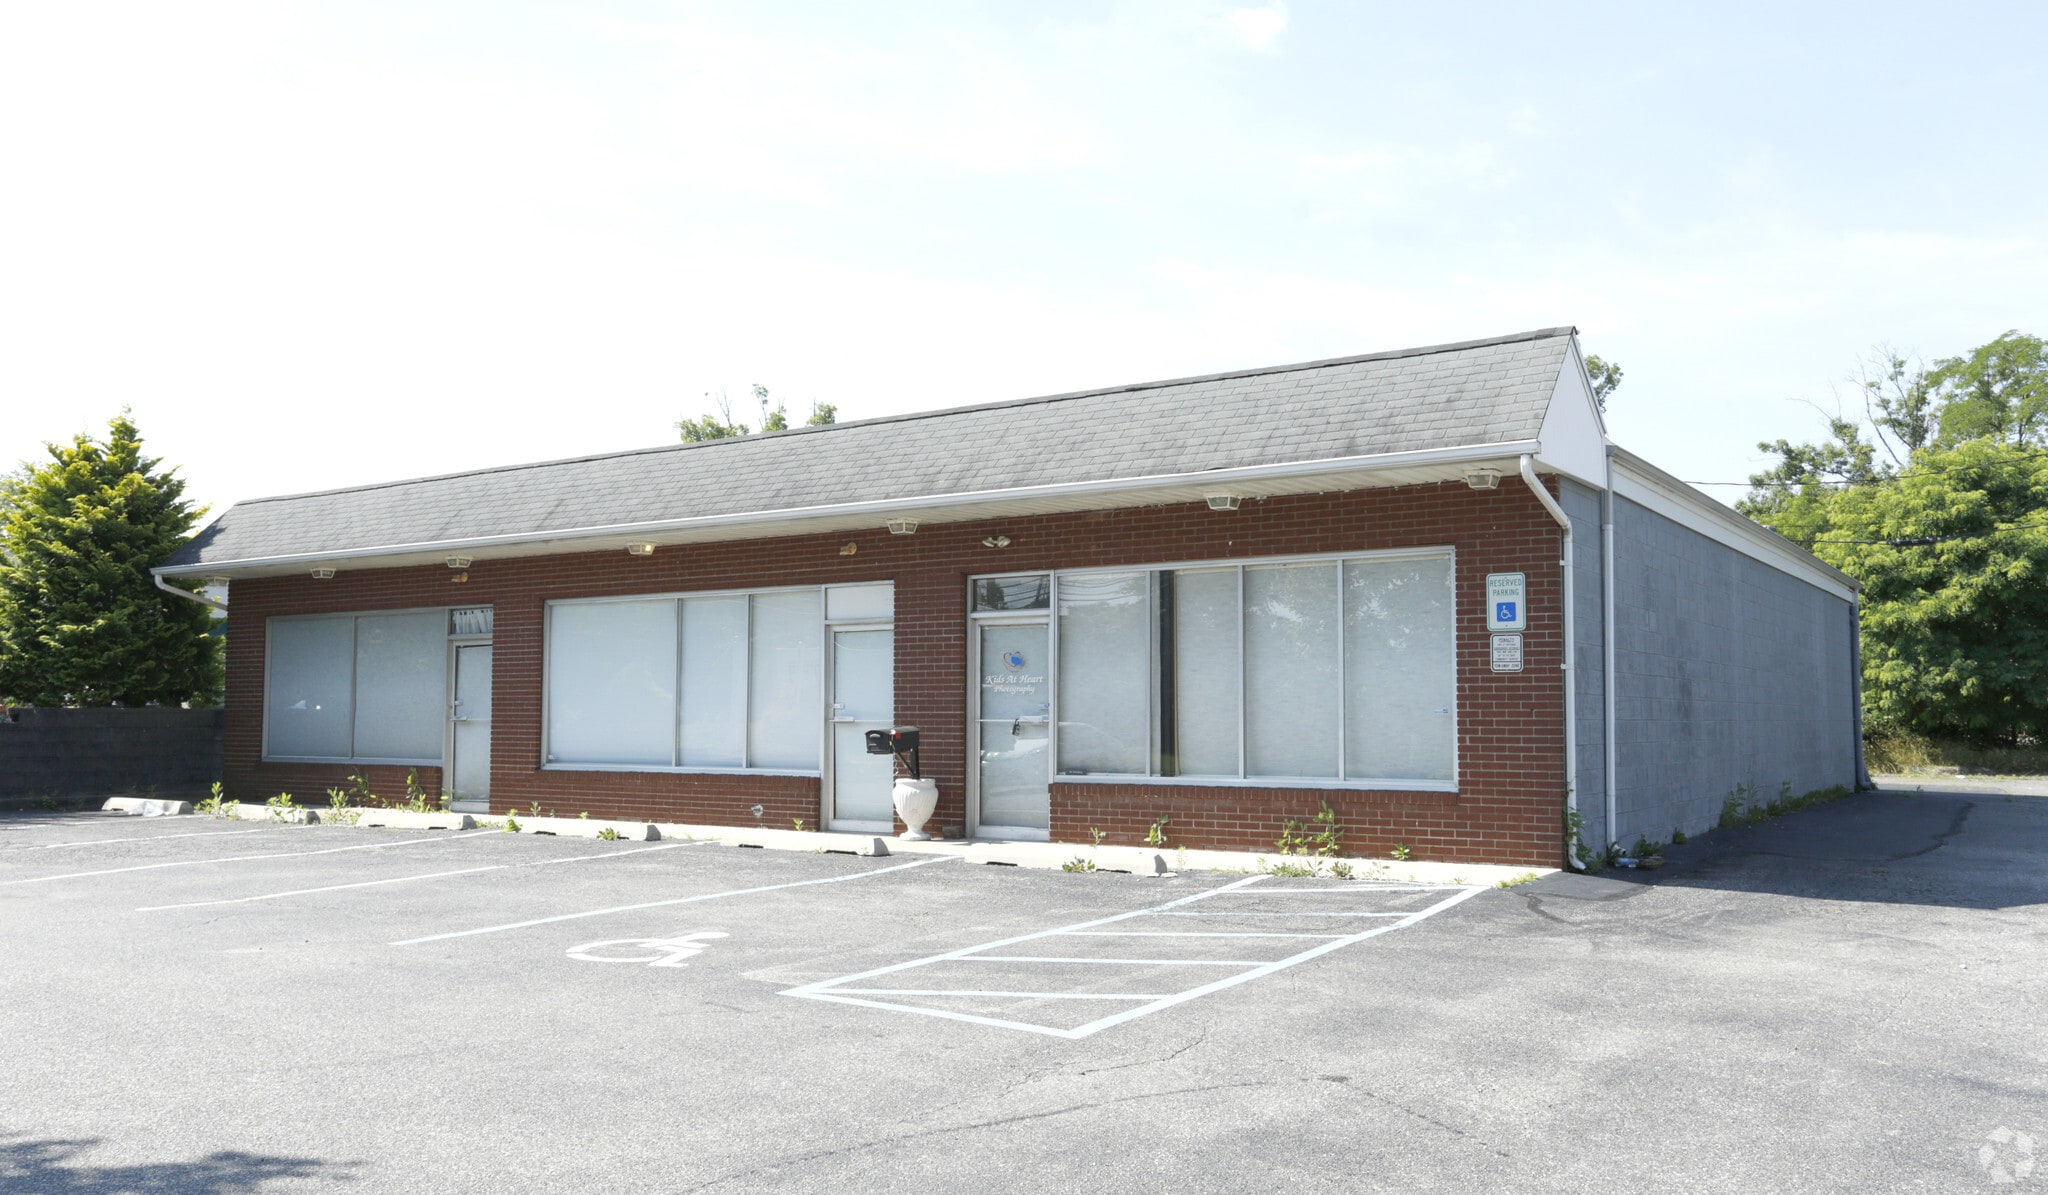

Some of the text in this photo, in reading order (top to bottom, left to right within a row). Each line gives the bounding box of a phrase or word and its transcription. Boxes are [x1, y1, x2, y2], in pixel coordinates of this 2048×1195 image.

[1489, 578, 1522, 588] RESERVED
[1492, 588, 1520, 597] PARKING
[985, 674, 1043, 684] Kids At Heart
[993, 684, 1035, 695] Photography
